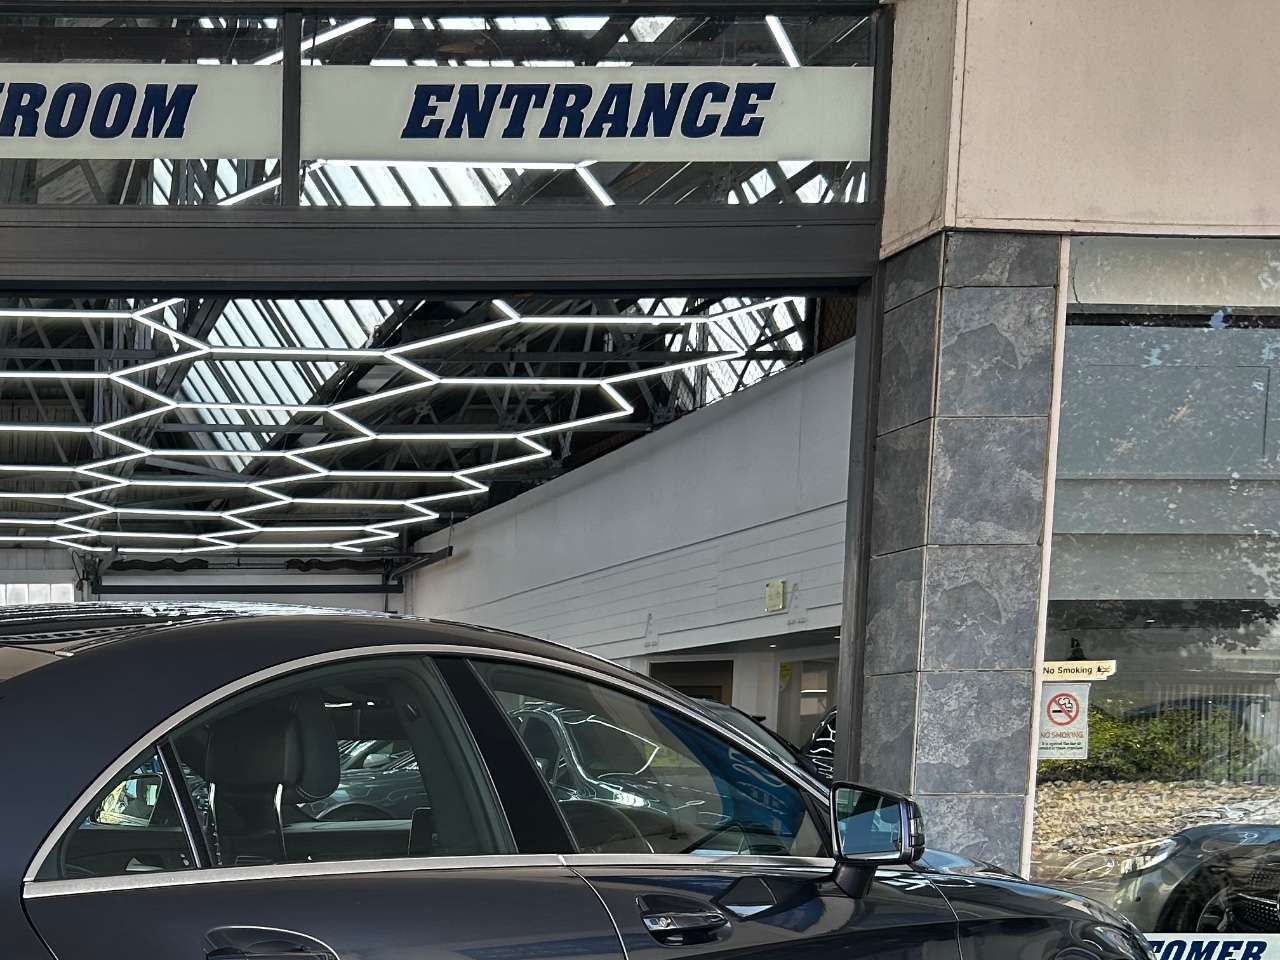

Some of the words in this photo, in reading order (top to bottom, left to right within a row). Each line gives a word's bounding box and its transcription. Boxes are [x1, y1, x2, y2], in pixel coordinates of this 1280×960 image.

[400, 81, 776, 139] ENTRANCE
[1042, 666, 1055, 675] No
[1057, 666, 1093, 676] Smoking
